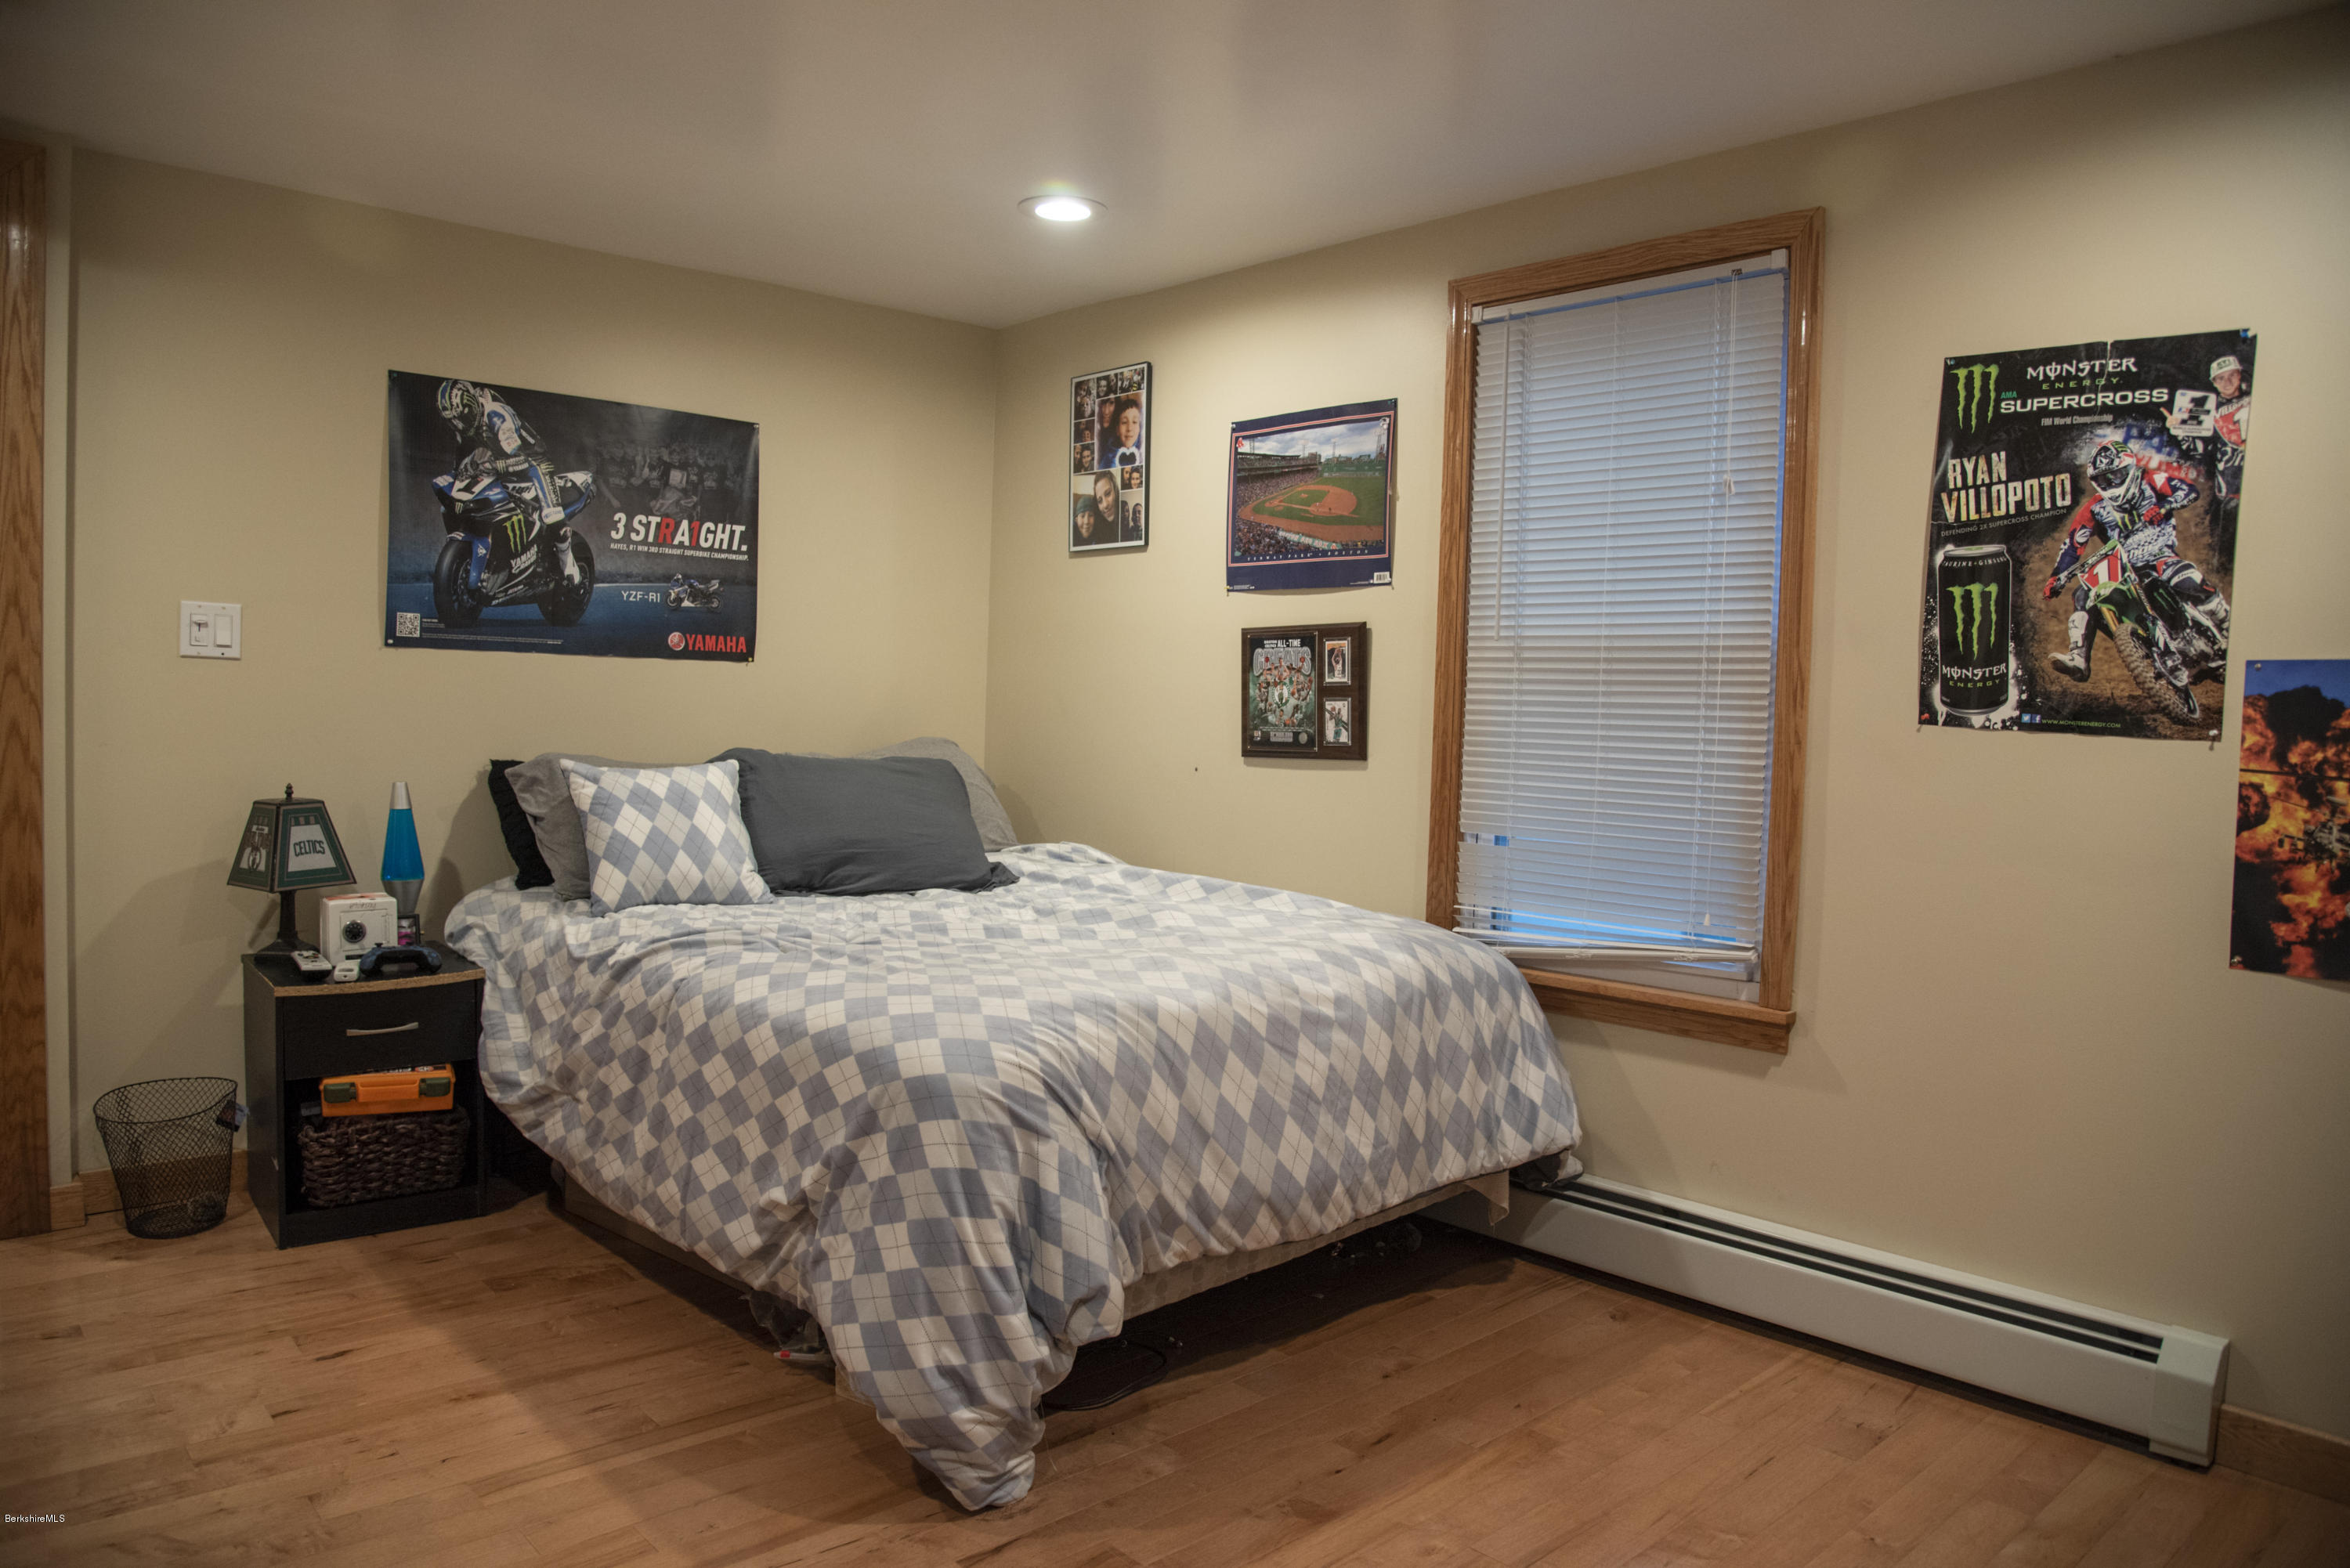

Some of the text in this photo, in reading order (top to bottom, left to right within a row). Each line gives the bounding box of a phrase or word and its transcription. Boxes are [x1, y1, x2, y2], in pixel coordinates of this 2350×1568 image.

[2026, 357, 2138, 381] MONSTER
[2041, 377, 2120, 390] ENERGY
[2001, 391, 2018, 399] AMA
[2001, 388, 2169, 414] SUPERCROSS
[2041, 414, 2113, 427] FIM World Championship
[1947, 451, 2007, 490] RYAN
[1940, 473, 2072, 523] VILLOPOTO
[610, 512, 627, 540] 3
[1941, 526, 1978, 537] DEFENDING
[1989, 516, 2029, 529] SUPERCROSS
[2030, 509, 2067, 521] CHAMPION
[610, 543, 628, 551] HAYES,
[684, 549, 710, 558] SUPERBIKE
[711, 552, 749, 562] CHAMPIONSHIP.
[621, 591, 660, 603] YZF-R1
[686, 634, 747, 653] YAMAHA
[1942, 663, 2007, 680] MONSTER
[1949, 679, 2001, 688] ENERGY
[293, 840, 325, 857] CELTICS
